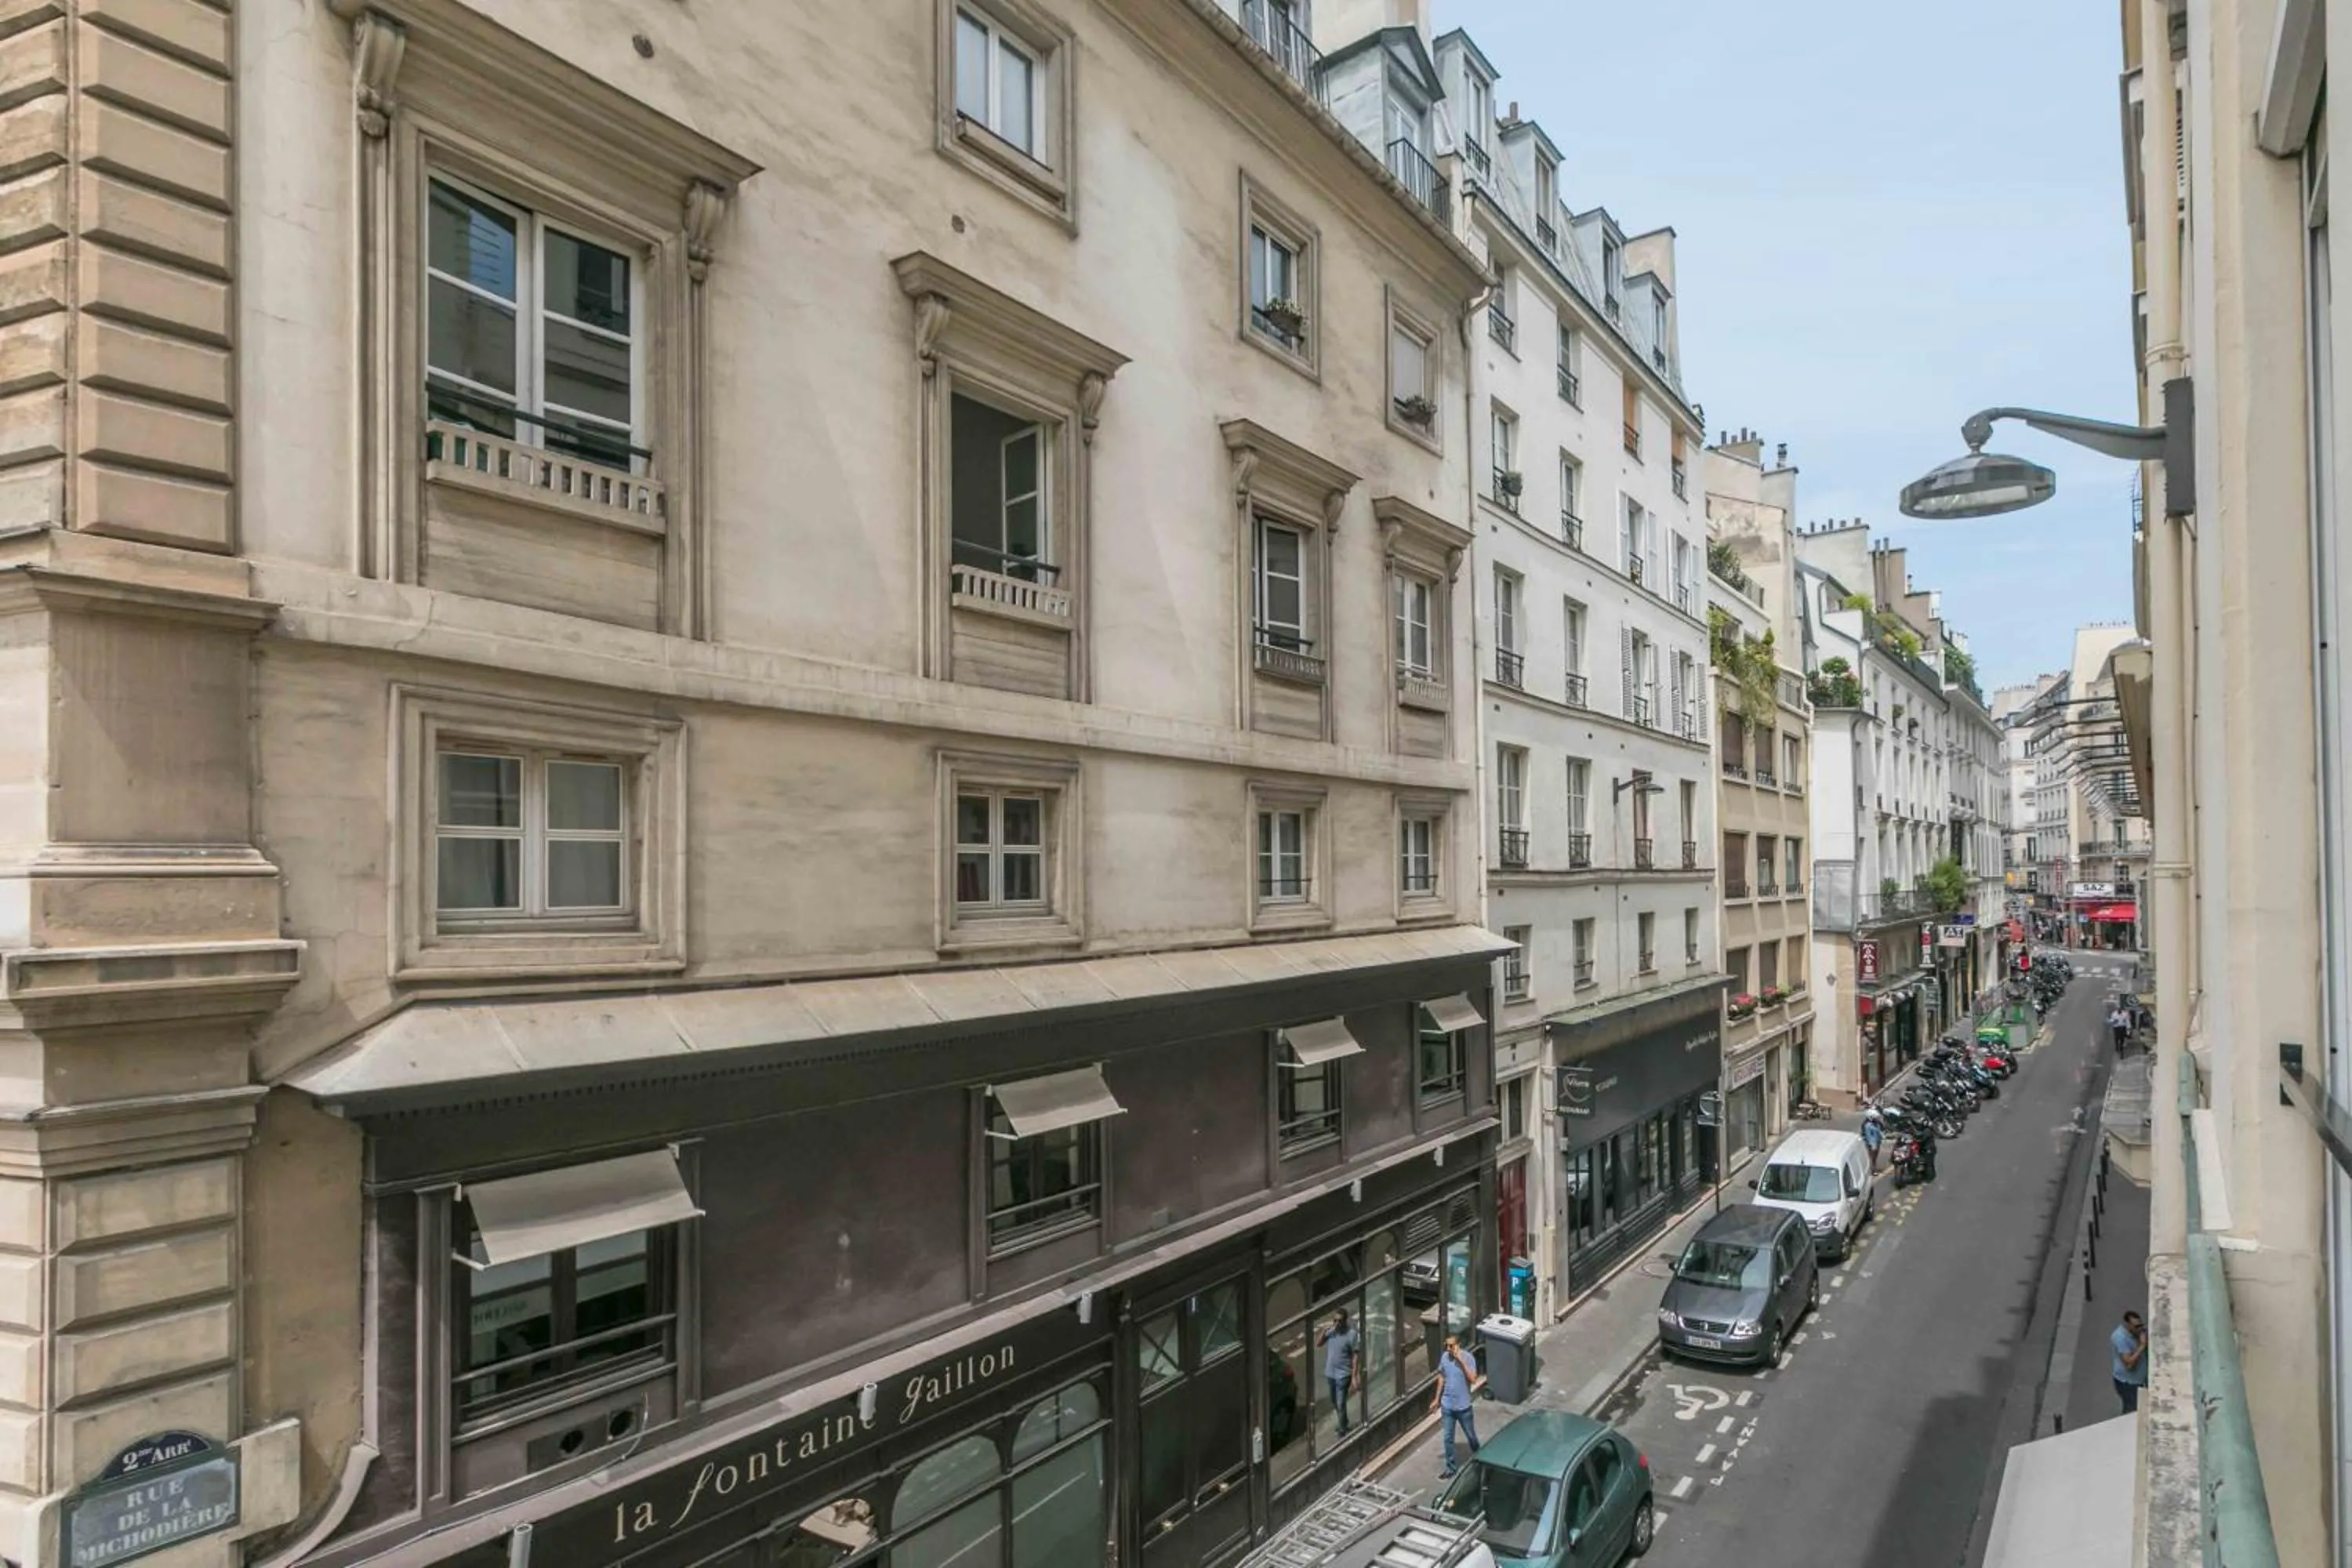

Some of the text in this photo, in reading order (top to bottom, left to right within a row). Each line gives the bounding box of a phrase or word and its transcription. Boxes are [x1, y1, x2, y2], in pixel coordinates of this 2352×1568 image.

[614, 1502, 658, 1543] la
[899, 1345, 1015, 1425] gaillon
[1709, 1417, 1758, 1486] PAYANT
[118, 1497, 192, 1529] DE LA
[126, 1479, 184, 1508] RUE
